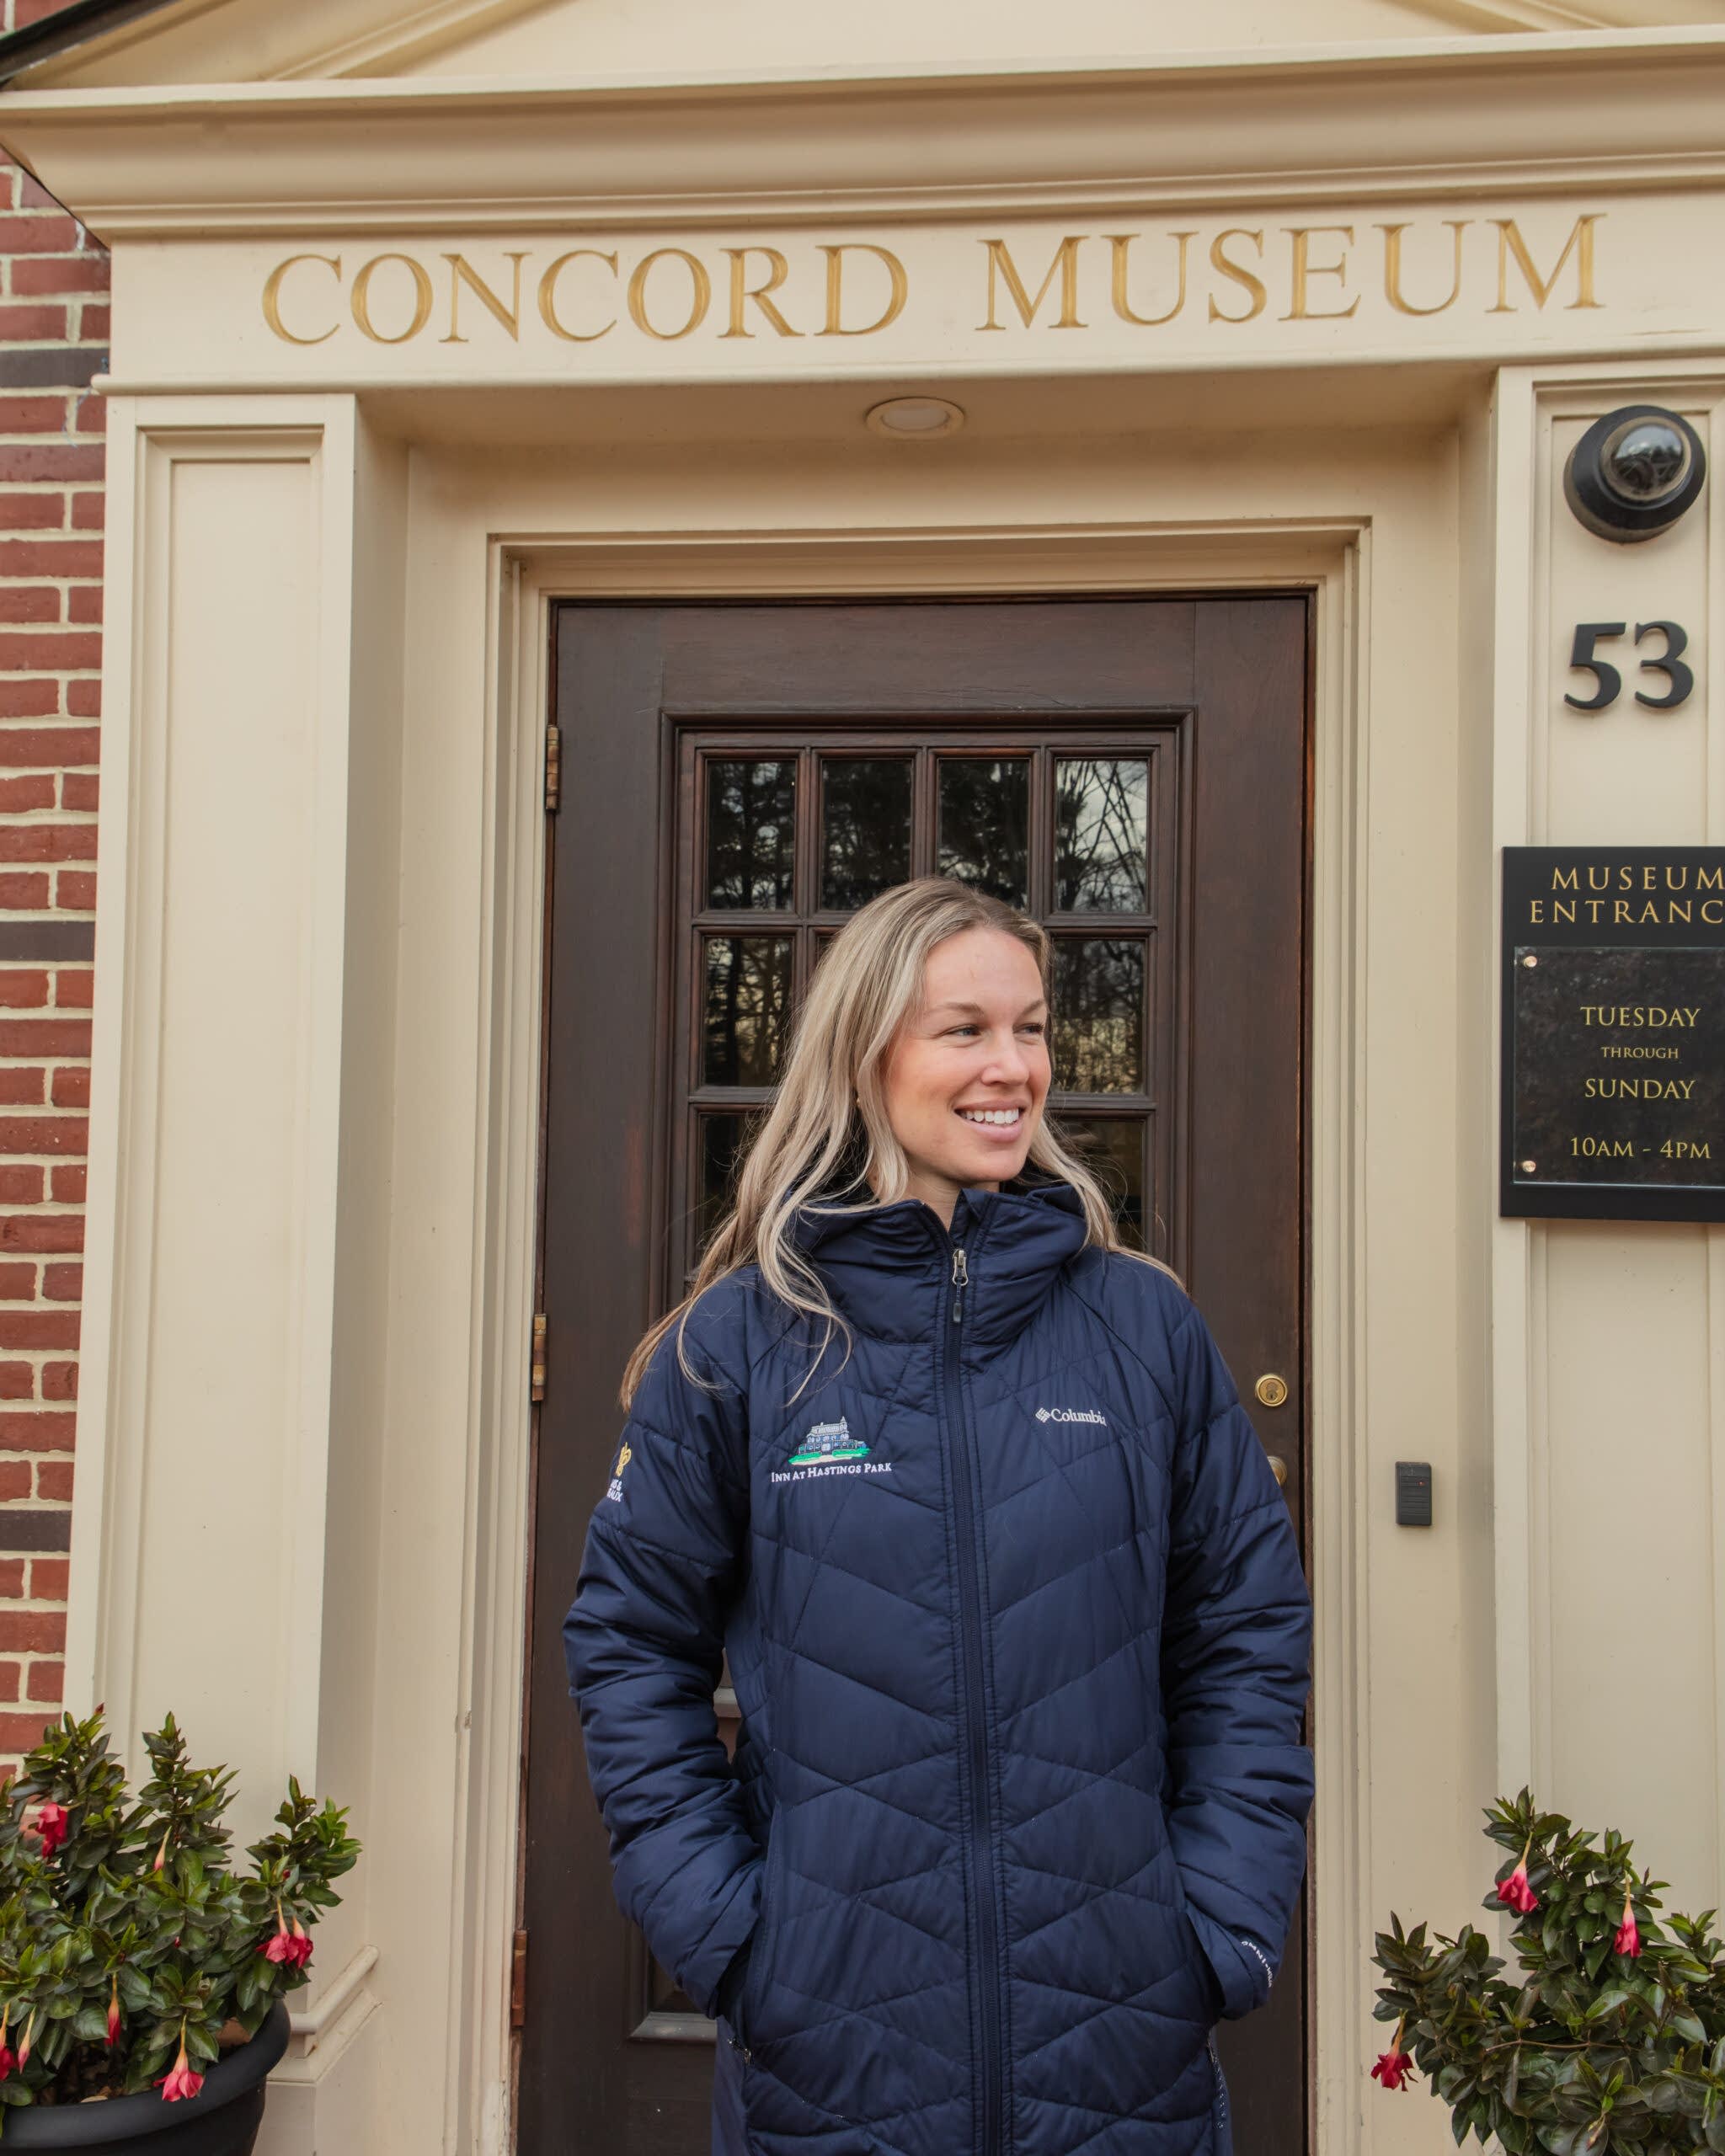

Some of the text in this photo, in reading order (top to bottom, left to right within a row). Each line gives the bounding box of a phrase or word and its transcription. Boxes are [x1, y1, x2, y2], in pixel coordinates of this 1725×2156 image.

[261, 211, 1608, 345] CONCORD MUSEUM
[1564, 621, 1694, 710] 53
[1551, 866, 1725, 891] MUSEUM
[1580, 1006, 1701, 1028] TUESDAY
[1600, 1046, 1680, 1060] THROUGH
[1583, 1078, 1697, 1101] SUNDAY
[1569, 1137, 1635, 1158] 10AM
[1659, 1139, 1712, 1160] 4PM
[1050, 1407, 1108, 1428] Columbia
[771, 1462, 893, 1483] INN AT HASTINGS PARK
